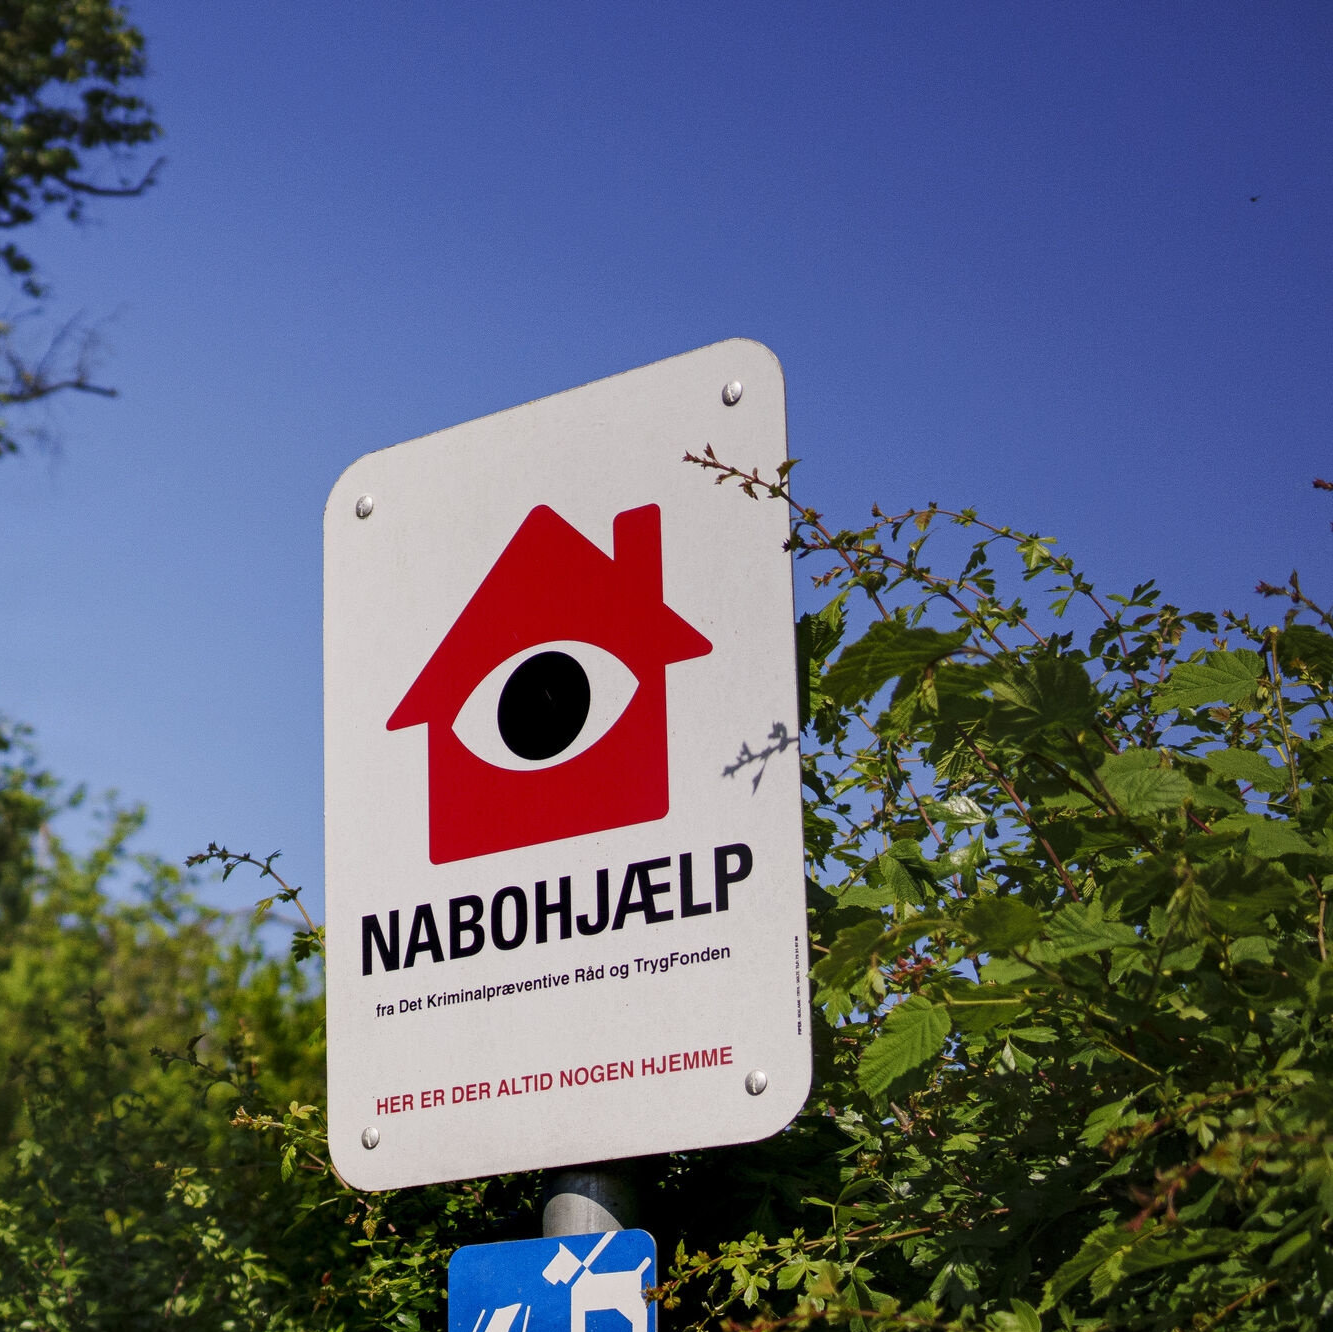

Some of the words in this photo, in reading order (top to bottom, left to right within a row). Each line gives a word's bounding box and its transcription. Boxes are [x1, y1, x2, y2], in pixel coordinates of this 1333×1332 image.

[360, 842, 754, 976] NABOHJÆLP
[376, 1004, 395, 1018] fra
[399, 997, 423, 1014] Det
[427, 973, 570, 1009] Kriminalpræventive
[575, 965, 605, 983] Råd
[609, 964, 629, 979] og
[634, 946, 731, 975] TrygFonden
[376, 1093, 414, 1115] HER
[420, 1088, 445, 1109] ER
[452, 1082, 491, 1104] DER
[497, 1072, 553, 1097] ALTID
[559, 1060, 634, 1088] NOGEN
[641, 1046, 733, 1076] HJEMME
